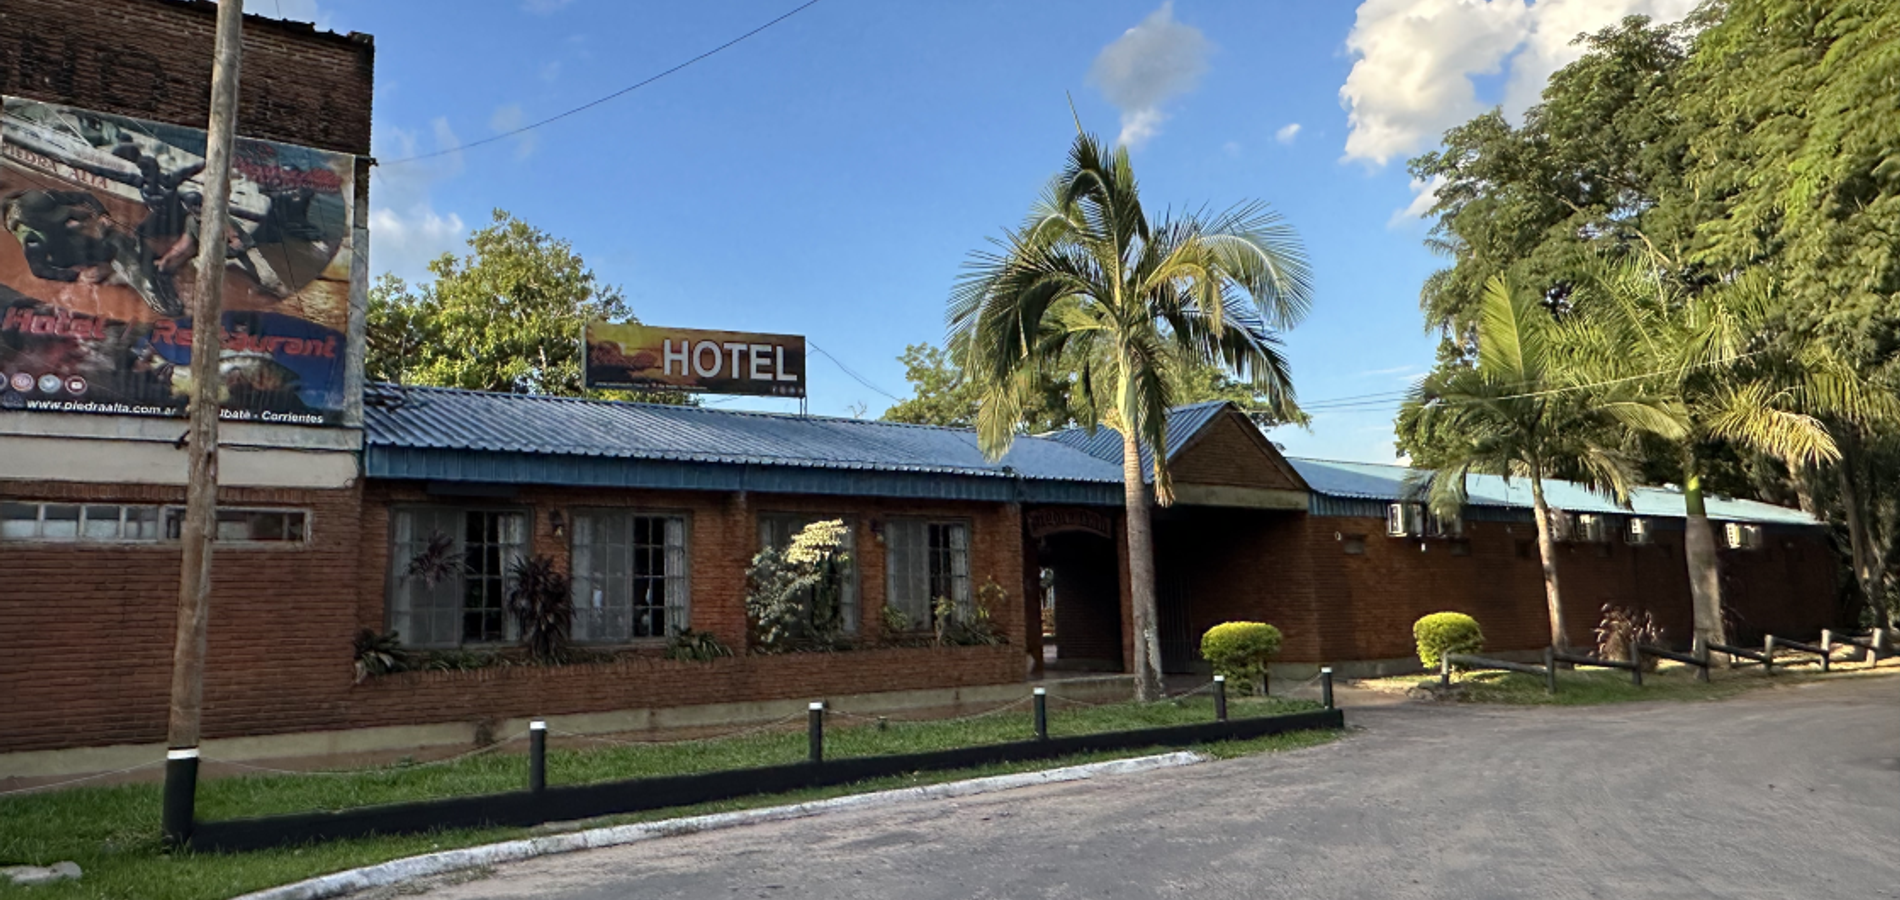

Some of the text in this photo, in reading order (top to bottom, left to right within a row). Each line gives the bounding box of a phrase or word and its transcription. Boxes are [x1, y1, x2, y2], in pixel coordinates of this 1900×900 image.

[2, 308, 106, 340] Hotel
[151, 319, 336, 358] Retaurant
[662, 338, 798, 382] HOTEL
[26, 400, 176, 416] www.piedraalta.com.ar
[261, 410, 324, 424] Corrientes
